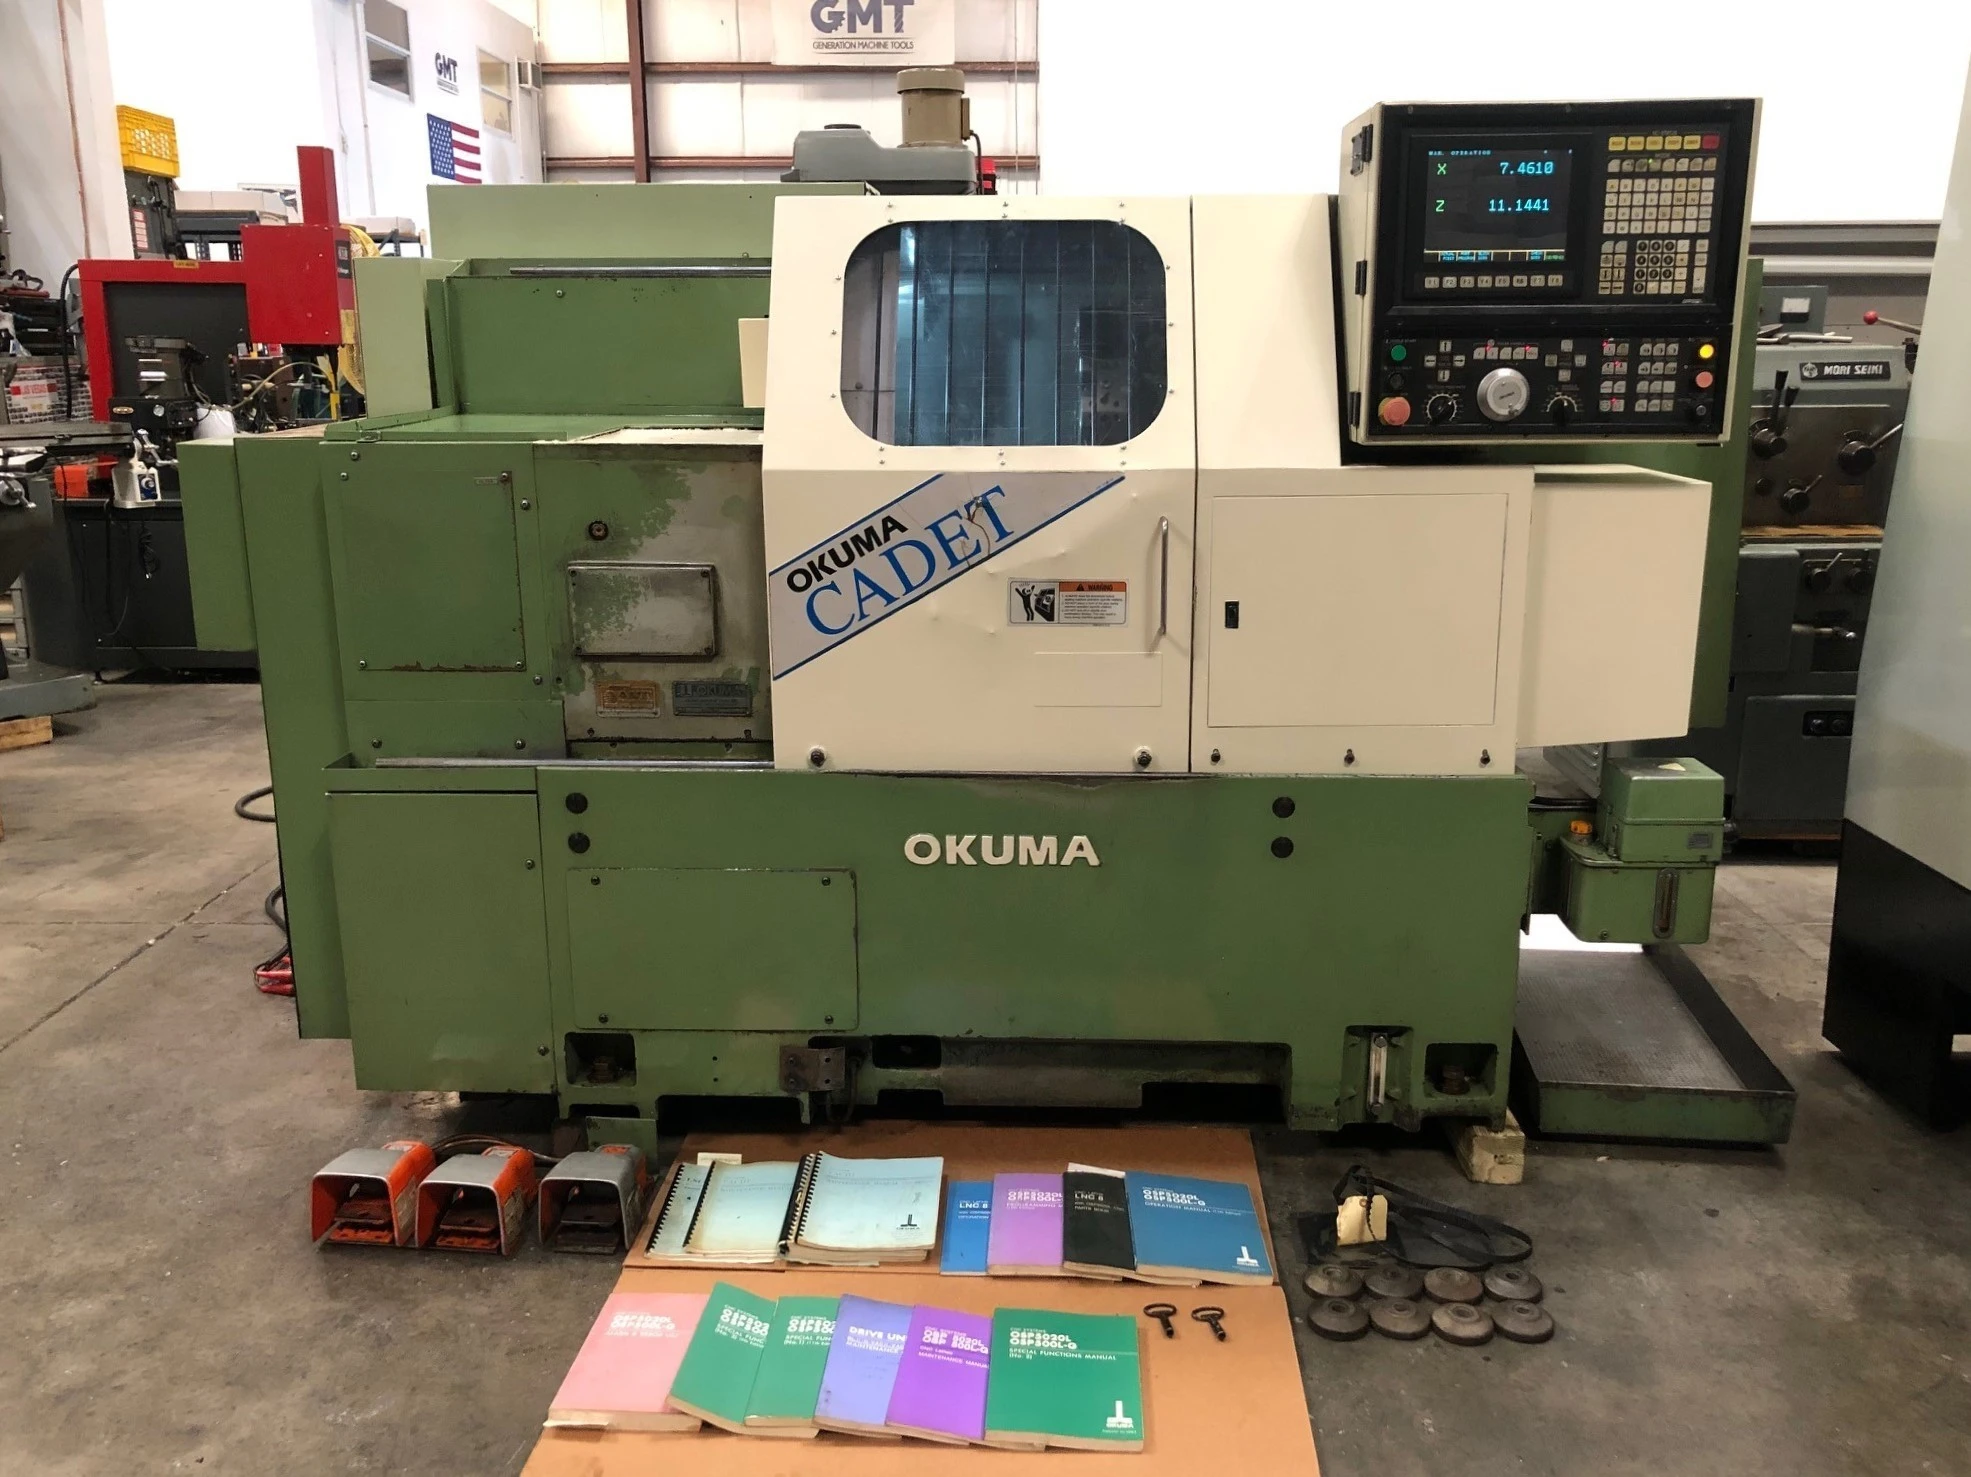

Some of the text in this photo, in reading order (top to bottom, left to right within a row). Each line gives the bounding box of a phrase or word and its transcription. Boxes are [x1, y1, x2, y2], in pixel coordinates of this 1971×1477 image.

[810, 0, 915, 33] GMT
[813, 41, 914, 49] GENERATION MACHINE TOOLS
[435, 52, 458, 82] GMT
[1437, 162, 1554, 175] X 7.4610
[1435, 198, 1550, 212] Z 11.1441
[1824, 365, 1883, 375] MORI SEIKI
[787, 515, 908, 593] OKUMA
[806, 485, 1014, 635] CADET
[1088, 583, 1113, 591] WARNING
[904, 833, 1101, 866] OKUMA
[1144, 1201, 1181, 1210] OPERATION
[849, 1325, 884, 1339] DRIVE
[1009, 1347, 1037, 1356] SPECIAL
[1039, 1351, 1082, 1359] FUNCTIONS
